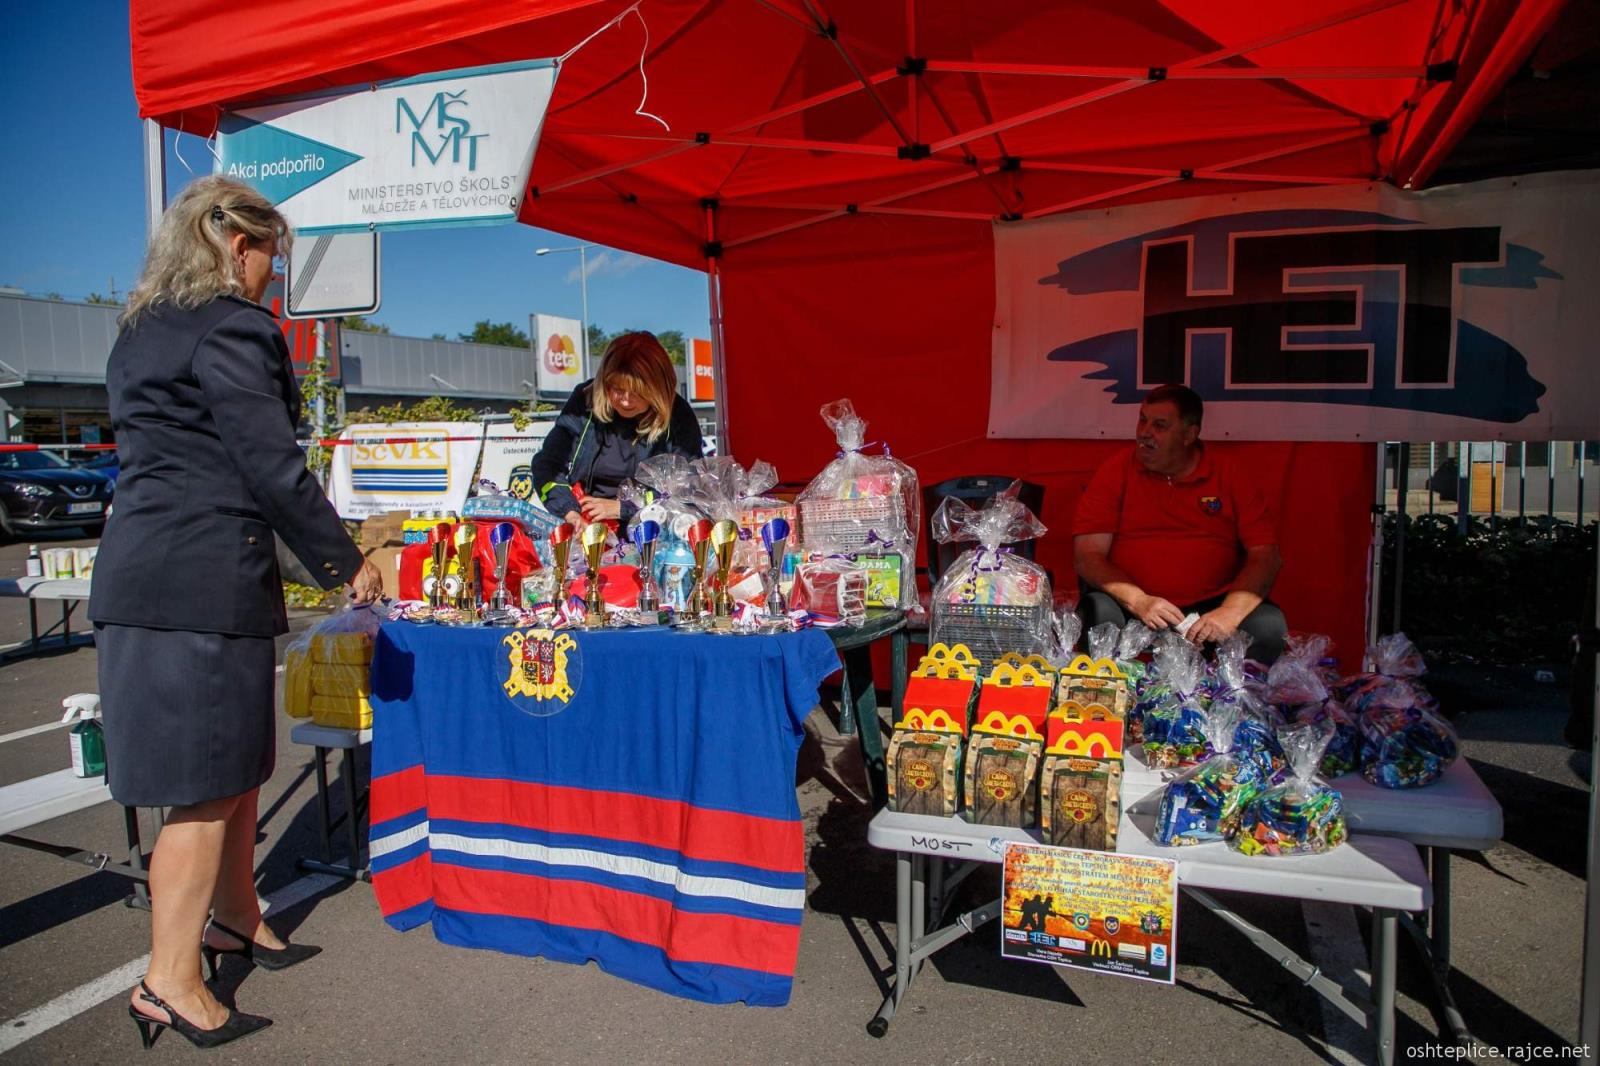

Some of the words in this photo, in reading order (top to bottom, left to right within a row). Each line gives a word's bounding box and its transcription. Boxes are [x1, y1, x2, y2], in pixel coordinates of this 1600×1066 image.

[228, 161, 257, 178] Akci
[261, 153, 325, 181] podpořilo
[349, 181, 453, 201] MINISTERSTVO
[362, 200, 415, 215] MLÁDEŽE
[419, 199, 428, 210] A
[1137, 226, 1505, 390] HET
[547, 348, 576, 370] teta
[911, 835, 973, 851] MOST
